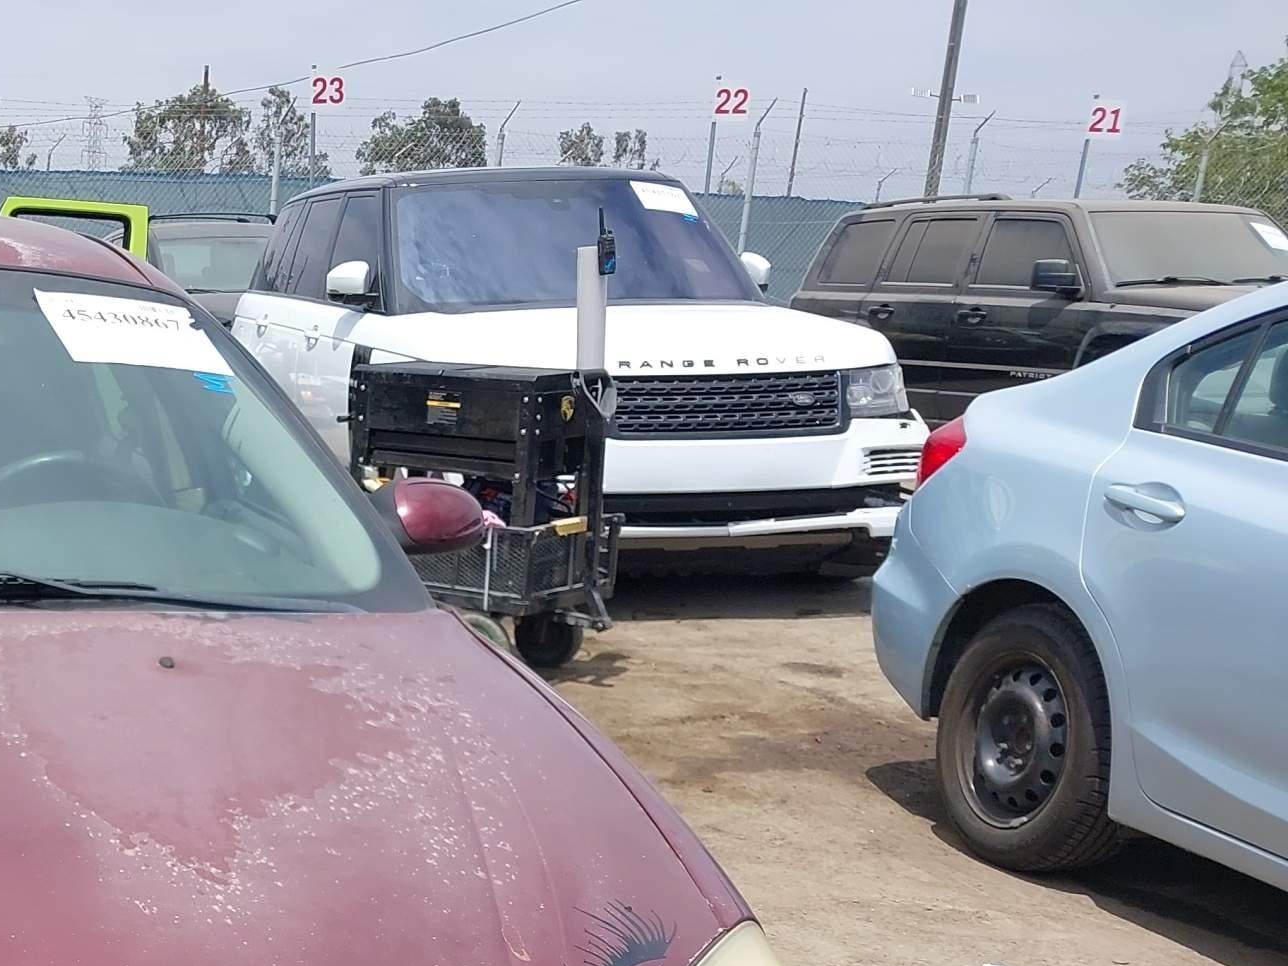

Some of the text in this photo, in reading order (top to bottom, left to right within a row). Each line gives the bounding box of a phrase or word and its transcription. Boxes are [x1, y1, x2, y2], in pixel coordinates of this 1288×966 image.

[312, 77, 344, 104] 23
[714, 88, 749, 114] 22
[1088, 107, 1121, 133] 21
[62, 307, 181, 331] 45430867
[618, 354, 825, 369] RANGE ROVER
